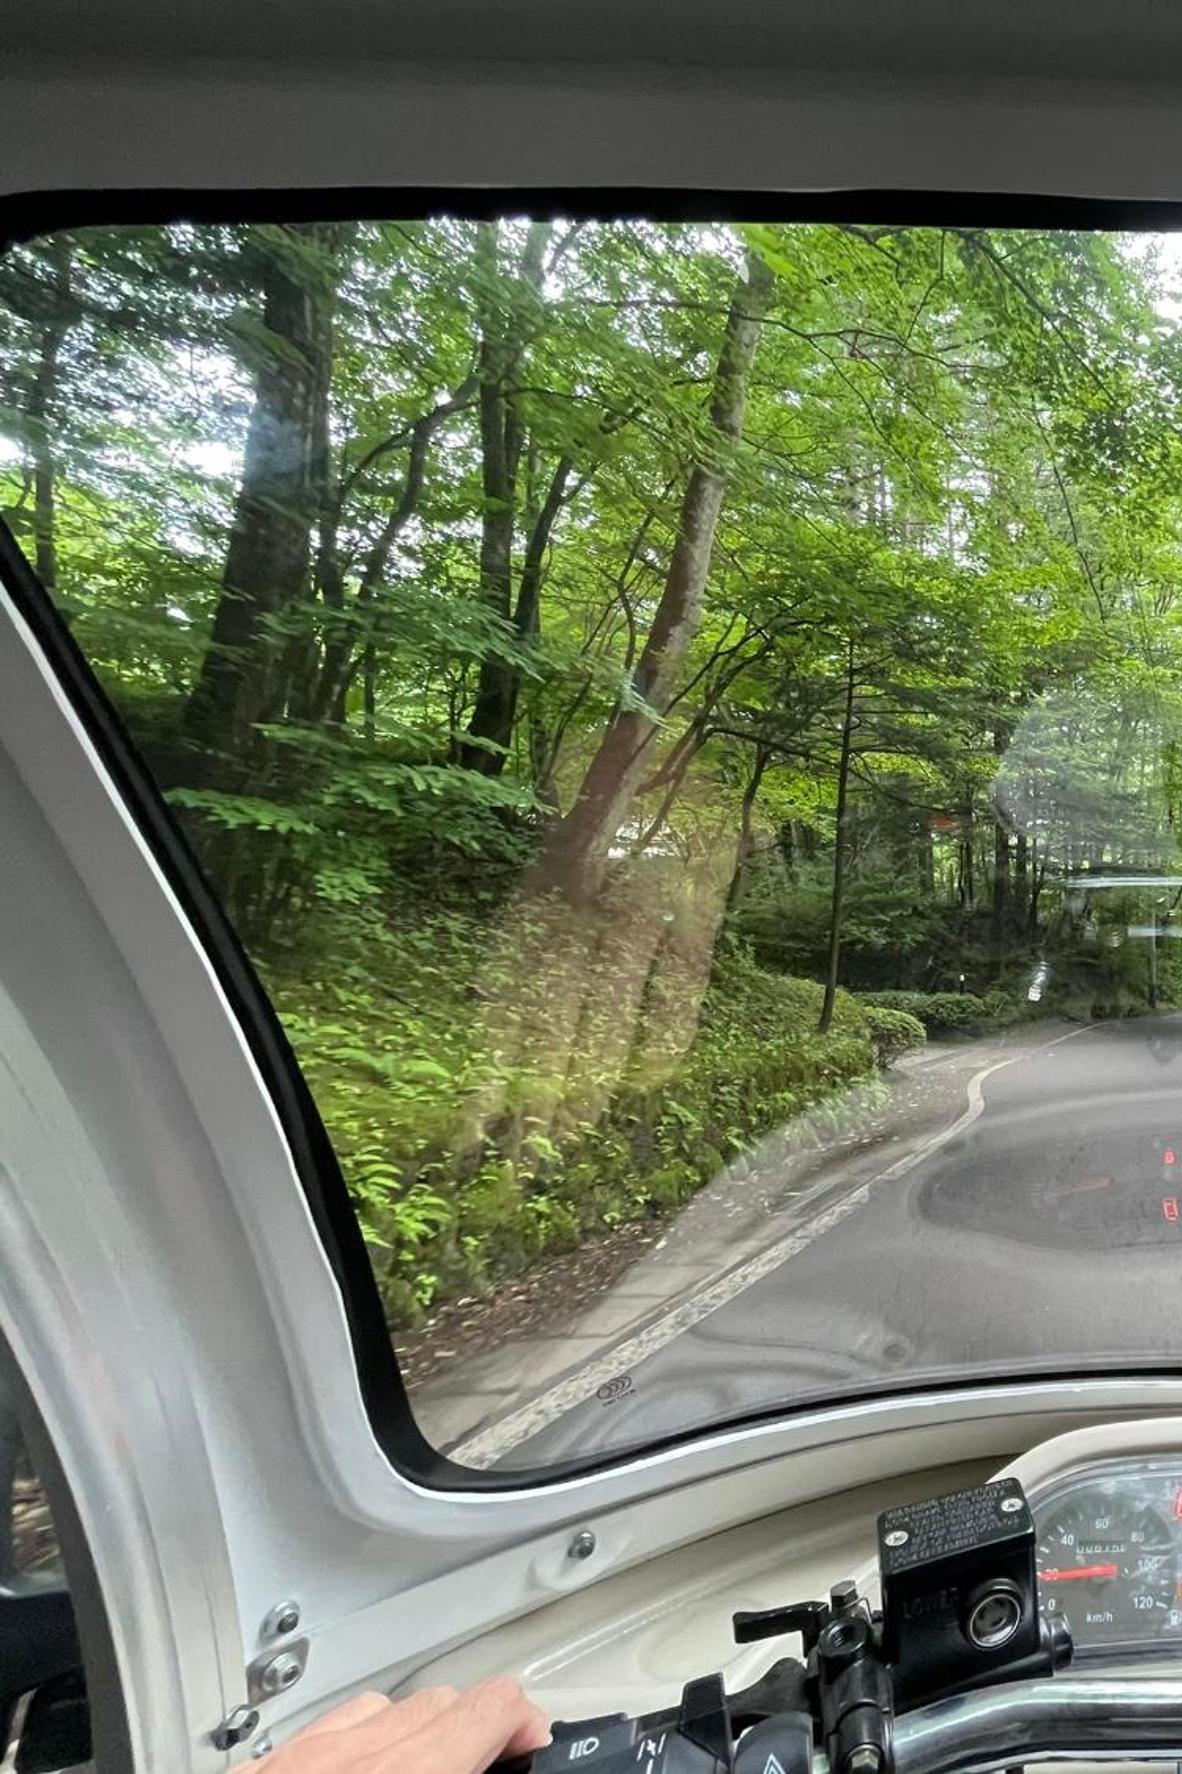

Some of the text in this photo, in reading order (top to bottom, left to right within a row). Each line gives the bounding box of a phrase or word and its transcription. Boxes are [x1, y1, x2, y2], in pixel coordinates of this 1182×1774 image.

[1095, 1518, 1110, 1529] 60
[1060, 1534, 1075, 1546] 40
[1047, 1598, 1056, 1611] 0
[1133, 1596, 1153, 1609] 120
[1085, 1611, 1114, 1623] km/h
